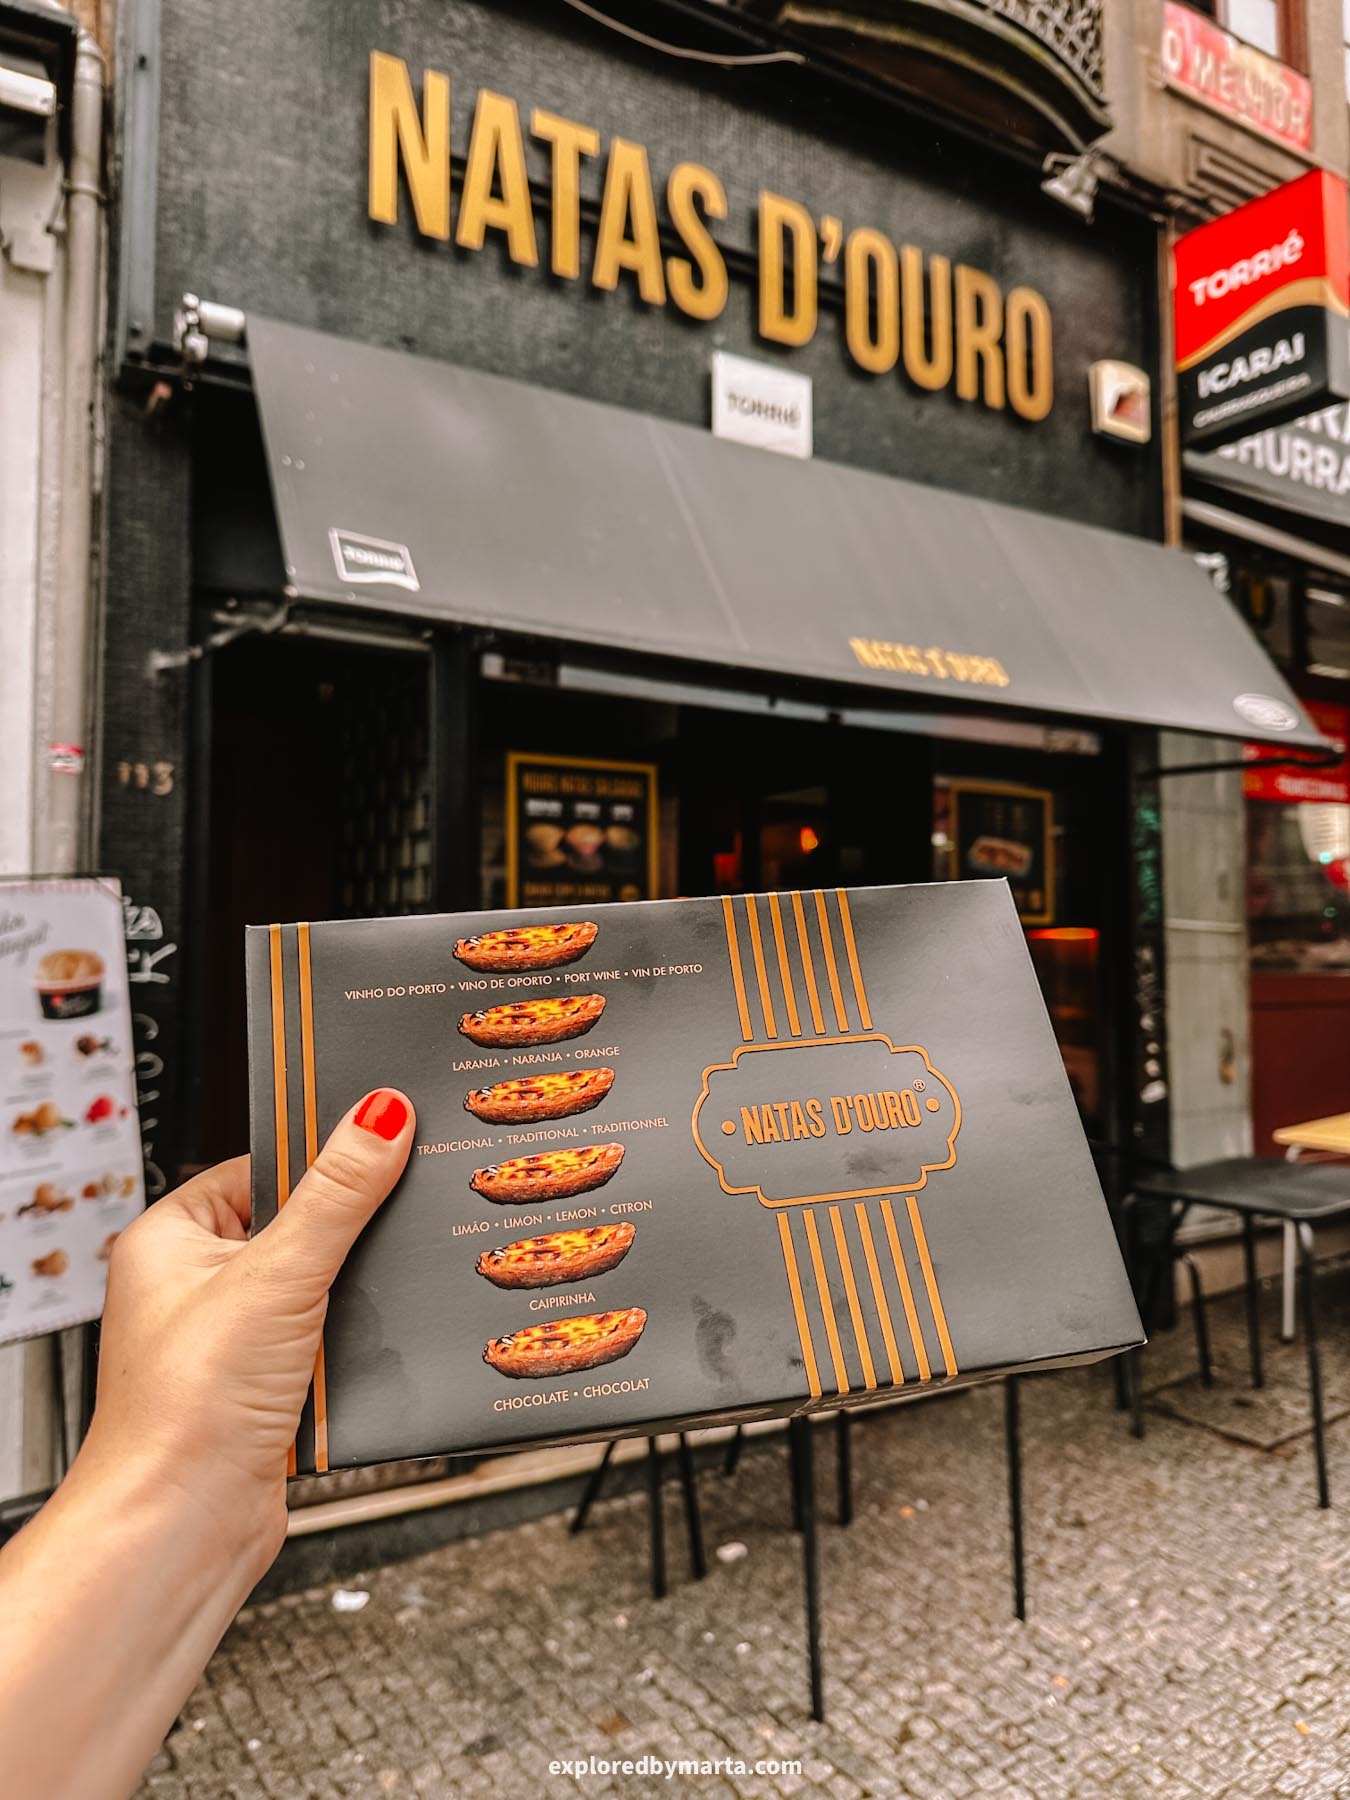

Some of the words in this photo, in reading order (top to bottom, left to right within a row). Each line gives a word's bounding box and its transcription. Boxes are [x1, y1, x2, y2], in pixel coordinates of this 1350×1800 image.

[369, 50, 728, 320] NATAS
[759, 190, 1052, 421] D'OURO
[1197, 331, 1306, 399] ICARAI
[345, 988, 384, 1000] VINHO
[387, 986, 406, 998] DO
[408, 983, 446, 995] PORTO
[458, 980, 488, 991] VINO
[490, 978, 505, 989] DE
[507, 975, 553, 988] OPORTO
[564, 972, 591, 983] PORT
[592, 969, 621, 981] WINE
[631, 967, 651, 978] VIN
[653, 966, 667, 977] DE
[669, 963, 703, 975] PORTO
[452, 1058, 500, 1072] LARANJA
[512, 1052, 563, 1065] NARANJA
[574, 1046, 620, 1060] ORANGE
[416, 1137, 494, 1156] TRADICIONAL
[506, 1127, 579, 1145] TRADITIONAL
[591, 1117, 669, 1135] TRADITIONNEL
[740, 1098, 827, 1145] NATAS
[452, 1220, 490, 1236] LIMÃO
[503, 1214, 543, 1229] LIMON
[556, 1207, 597, 1222] LEMON
[609, 1200, 653, 1215] CITRON
[529, 1292, 596, 1311] CAIPIRINHA
[493, 1389, 570, 1412] CHOCOLATE
[582, 1378, 650, 1399] CHOCOLAT
